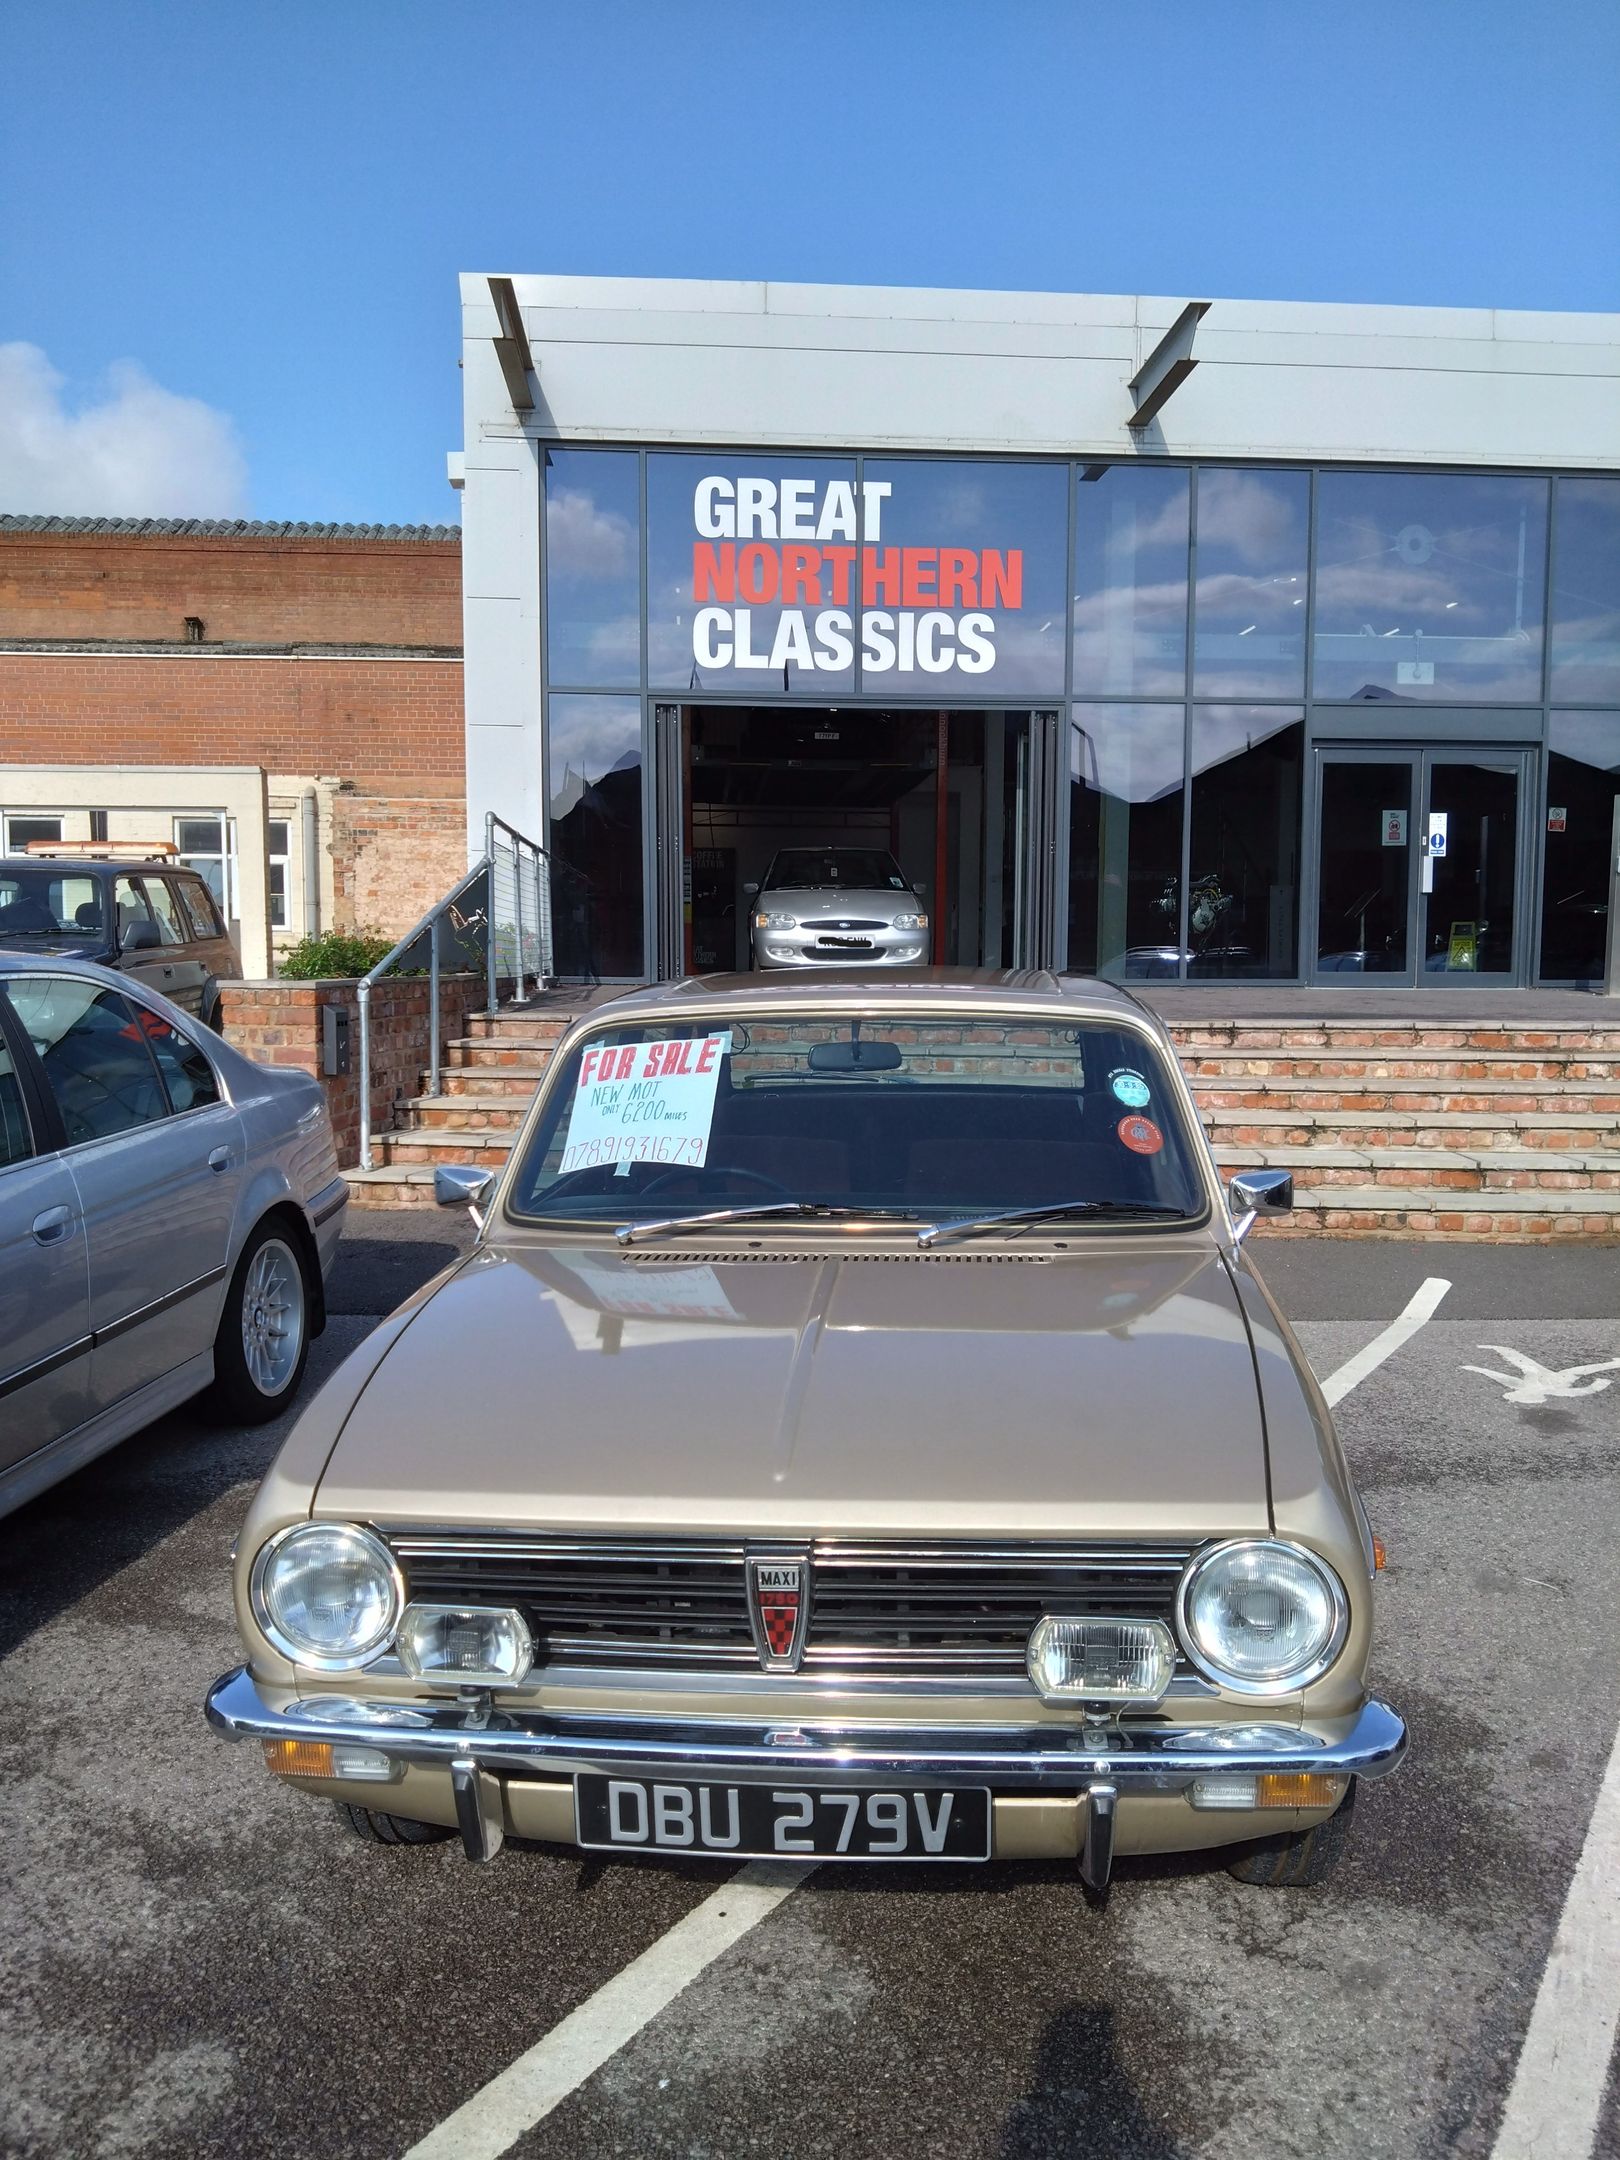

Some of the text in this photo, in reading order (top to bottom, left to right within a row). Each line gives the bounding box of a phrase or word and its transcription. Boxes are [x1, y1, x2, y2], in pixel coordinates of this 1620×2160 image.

[694, 476, 892, 542] GREAT
[693, 542, 1023, 609] NORTHERN
[693, 607, 996, 674] CLASSICS
[581, 1038, 721, 1087] FOR SALE
[591, 1081, 662, 1106] NEW MOT
[601, 1103, 621, 1116] ONLY
[621, 1100, 666, 1124] 6200
[562, 1136, 704, 1172] 07891931679
[760, 1592, 799, 1605] 1750
[761, 1571, 796, 1586] MAXI
[608, 1780, 955, 1854] DBU 279V
